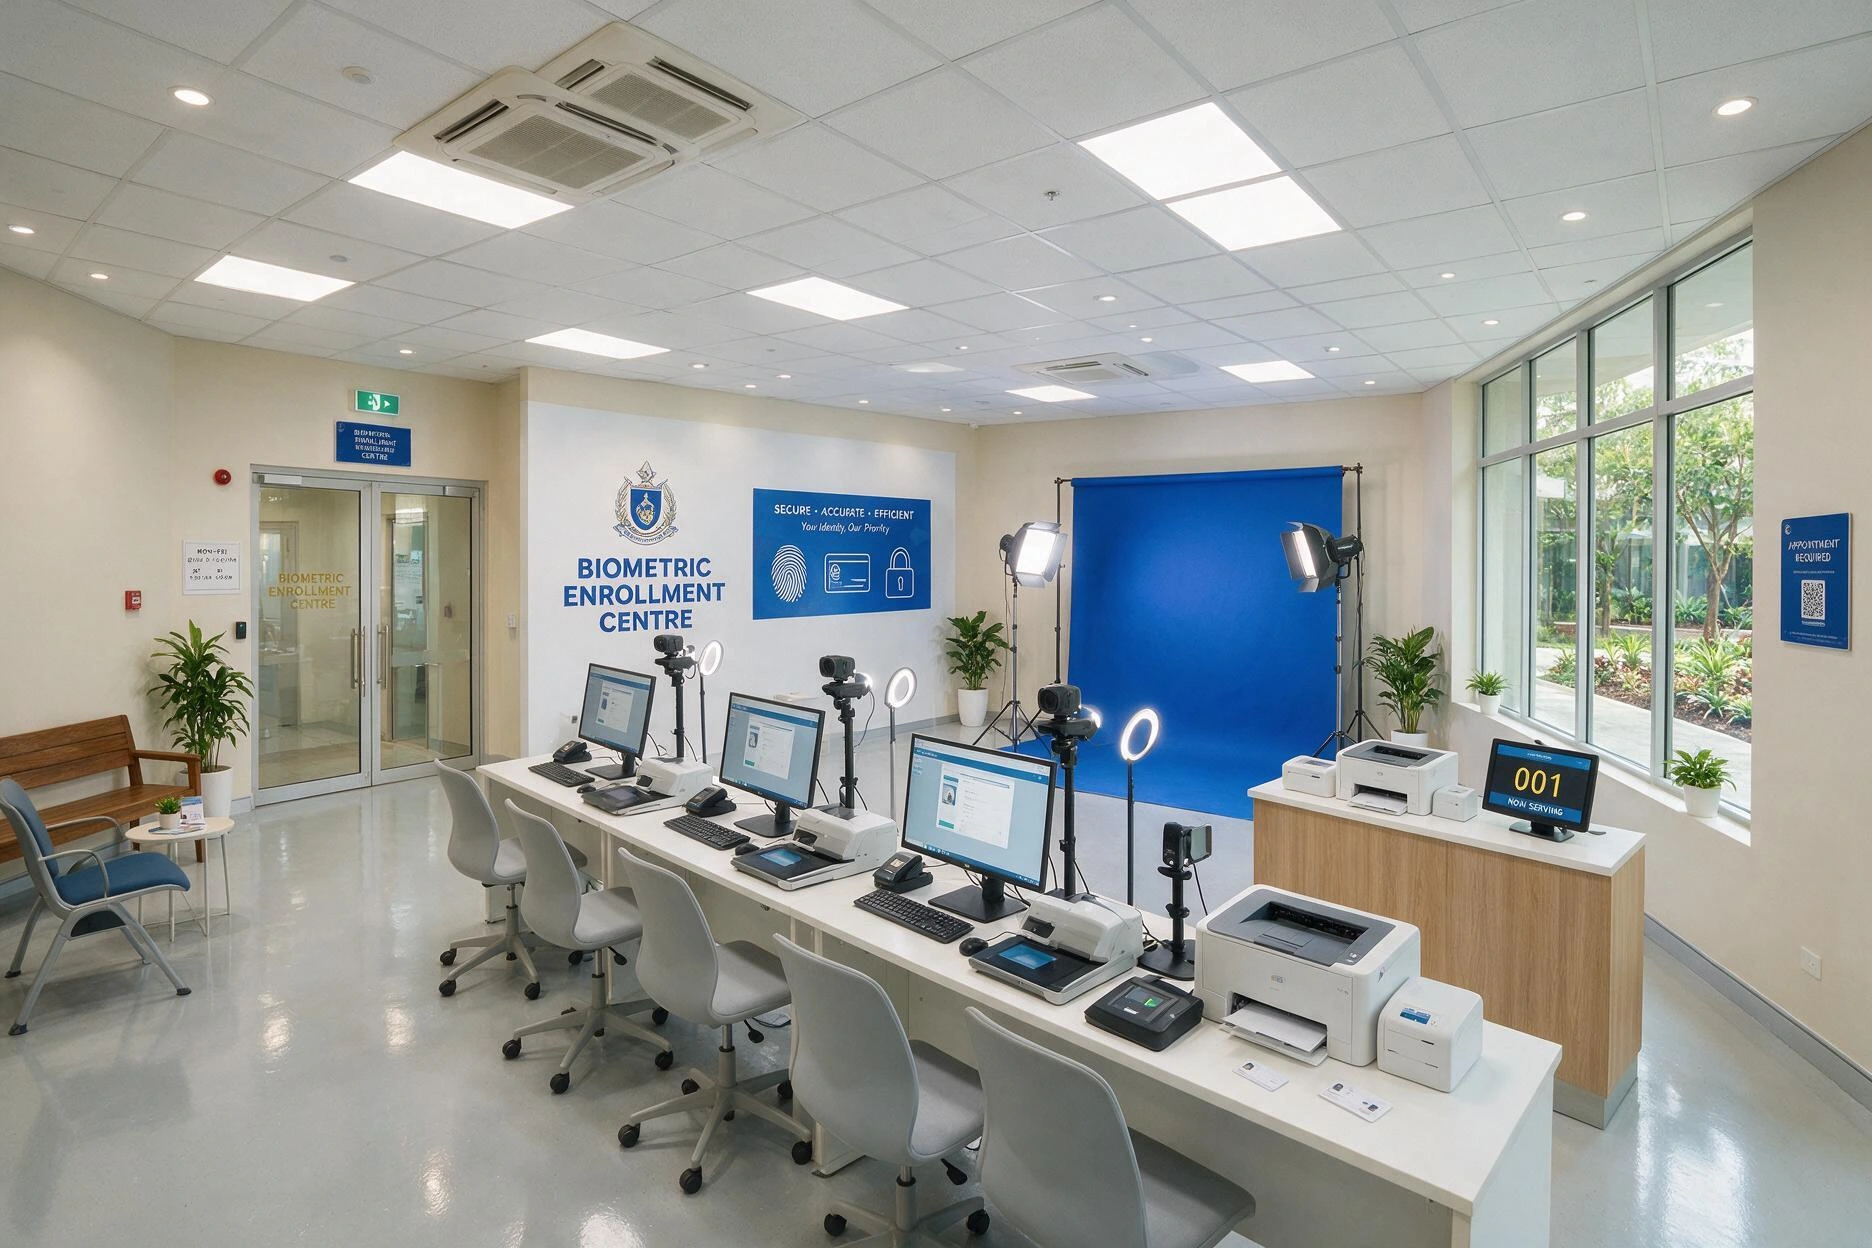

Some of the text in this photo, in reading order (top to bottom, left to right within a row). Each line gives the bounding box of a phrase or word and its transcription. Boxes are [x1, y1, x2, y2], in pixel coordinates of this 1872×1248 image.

[774, 504, 811, 516] SECURE
[874, 509, 914, 520] EFFICIENT
[801, 522, 817, 531] Your
[848, 523, 861, 532] Our
[578, 557, 711, 579] BIOMETRIC
[279, 573, 344, 584] BIOMETRIC
[268, 585, 352, 597] ENROLLMENT
[563, 582, 726, 607] ENROLLMENT
[290, 598, 336, 610] CENTRE
[599, 609, 693, 633] CENTRE
[1514, 766, 1561, 798] 001
